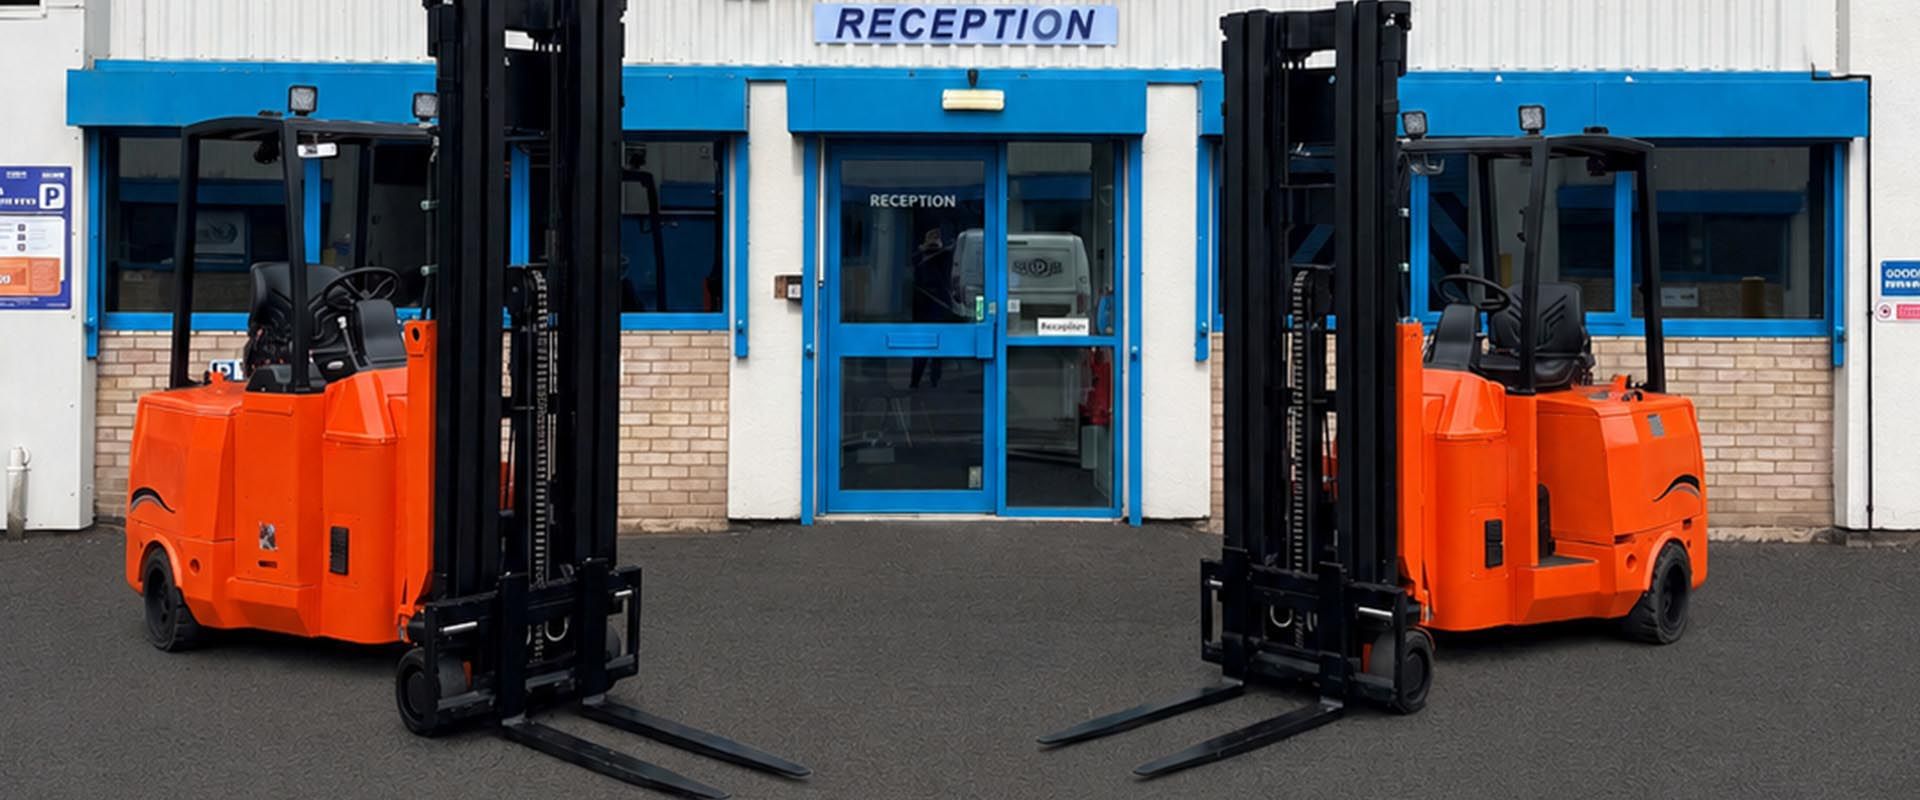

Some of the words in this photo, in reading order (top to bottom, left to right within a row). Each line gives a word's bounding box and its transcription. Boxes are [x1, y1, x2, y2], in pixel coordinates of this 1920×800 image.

[836, 8, 1095, 41] RECEPTION
[45, 187, 60, 206] P
[870, 193, 956, 208] RECEPTION
